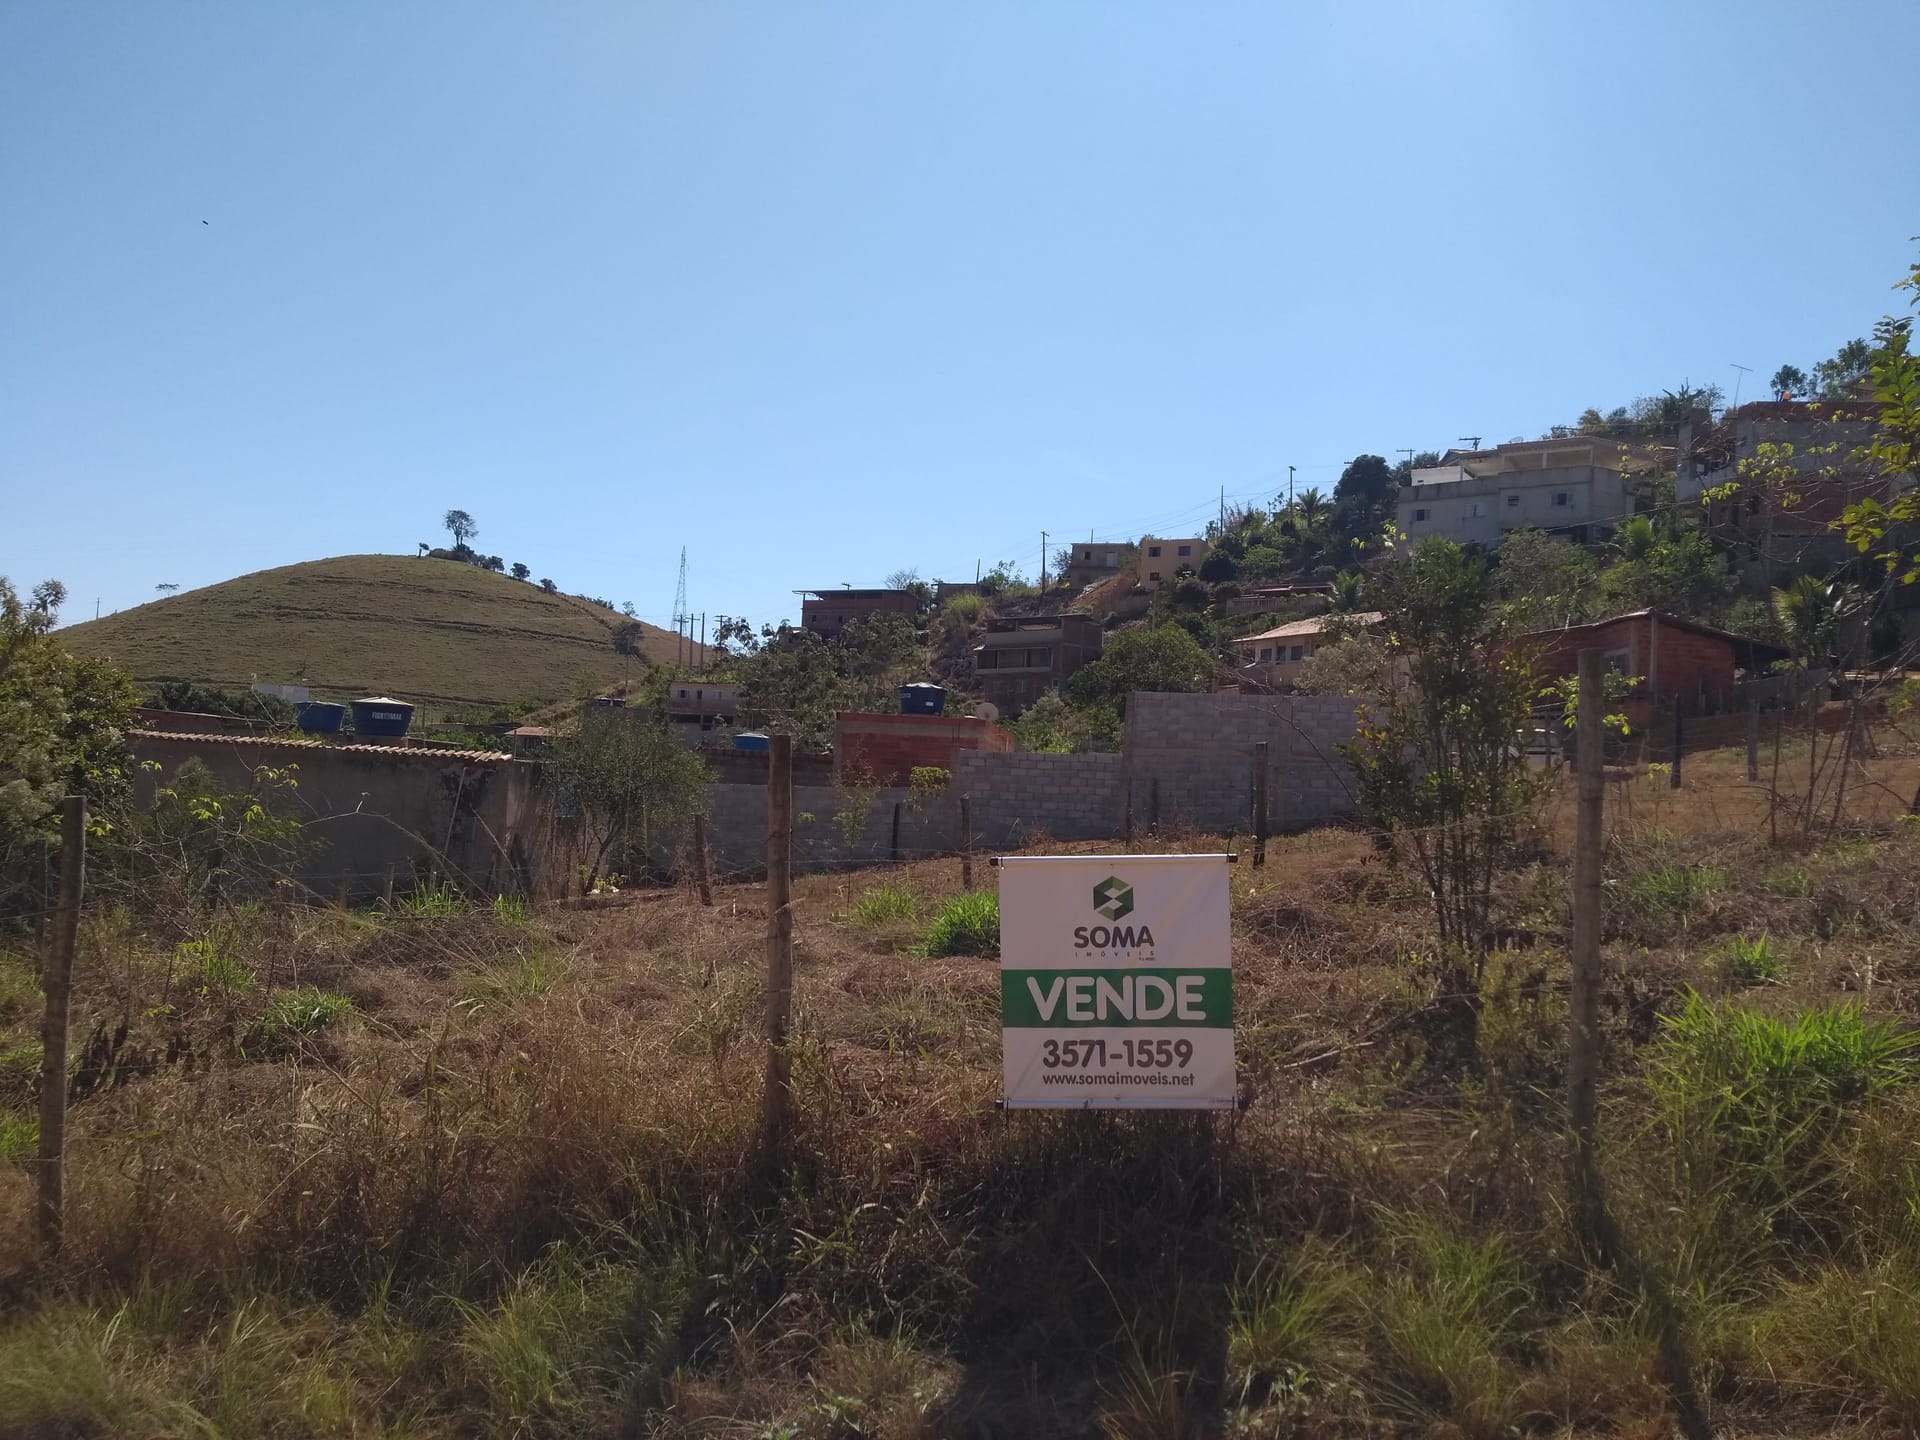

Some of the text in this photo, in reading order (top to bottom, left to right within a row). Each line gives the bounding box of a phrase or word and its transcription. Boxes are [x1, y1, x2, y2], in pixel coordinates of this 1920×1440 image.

[1074, 925, 1155, 948] SOMA
[1026, 975, 1207, 1021] VENDE
[1042, 1039, 1194, 1068] 3571-1559
[1042, 1072, 1195, 1086] www.somaimoveis.net
